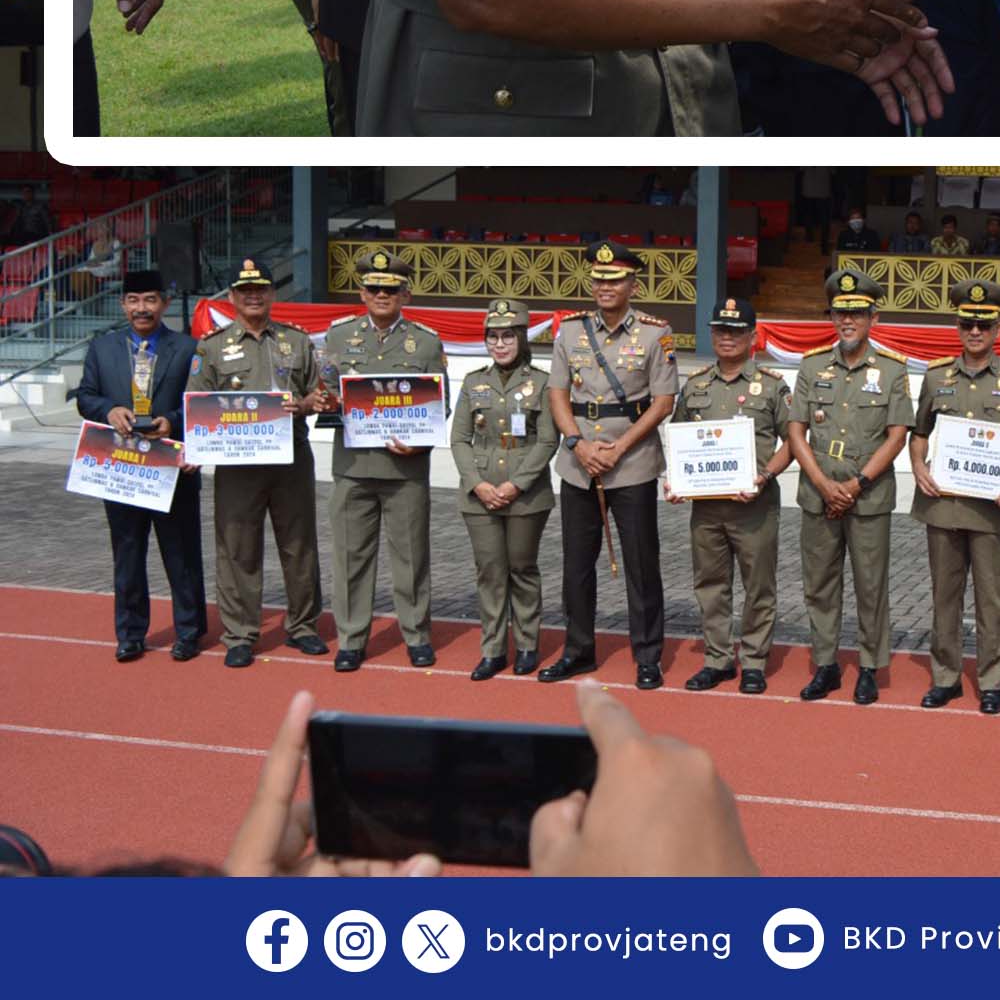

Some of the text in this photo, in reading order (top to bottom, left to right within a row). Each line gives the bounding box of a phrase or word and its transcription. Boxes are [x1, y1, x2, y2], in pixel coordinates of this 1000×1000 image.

[374, 395, 400, 406] JUARA
[220, 412, 248, 423] JUARA
[111, 449, 139, 463] JUARA
[684, 460, 738, 475] Rp. 5.000.000
[948, 458, 961, 471] Rp.
